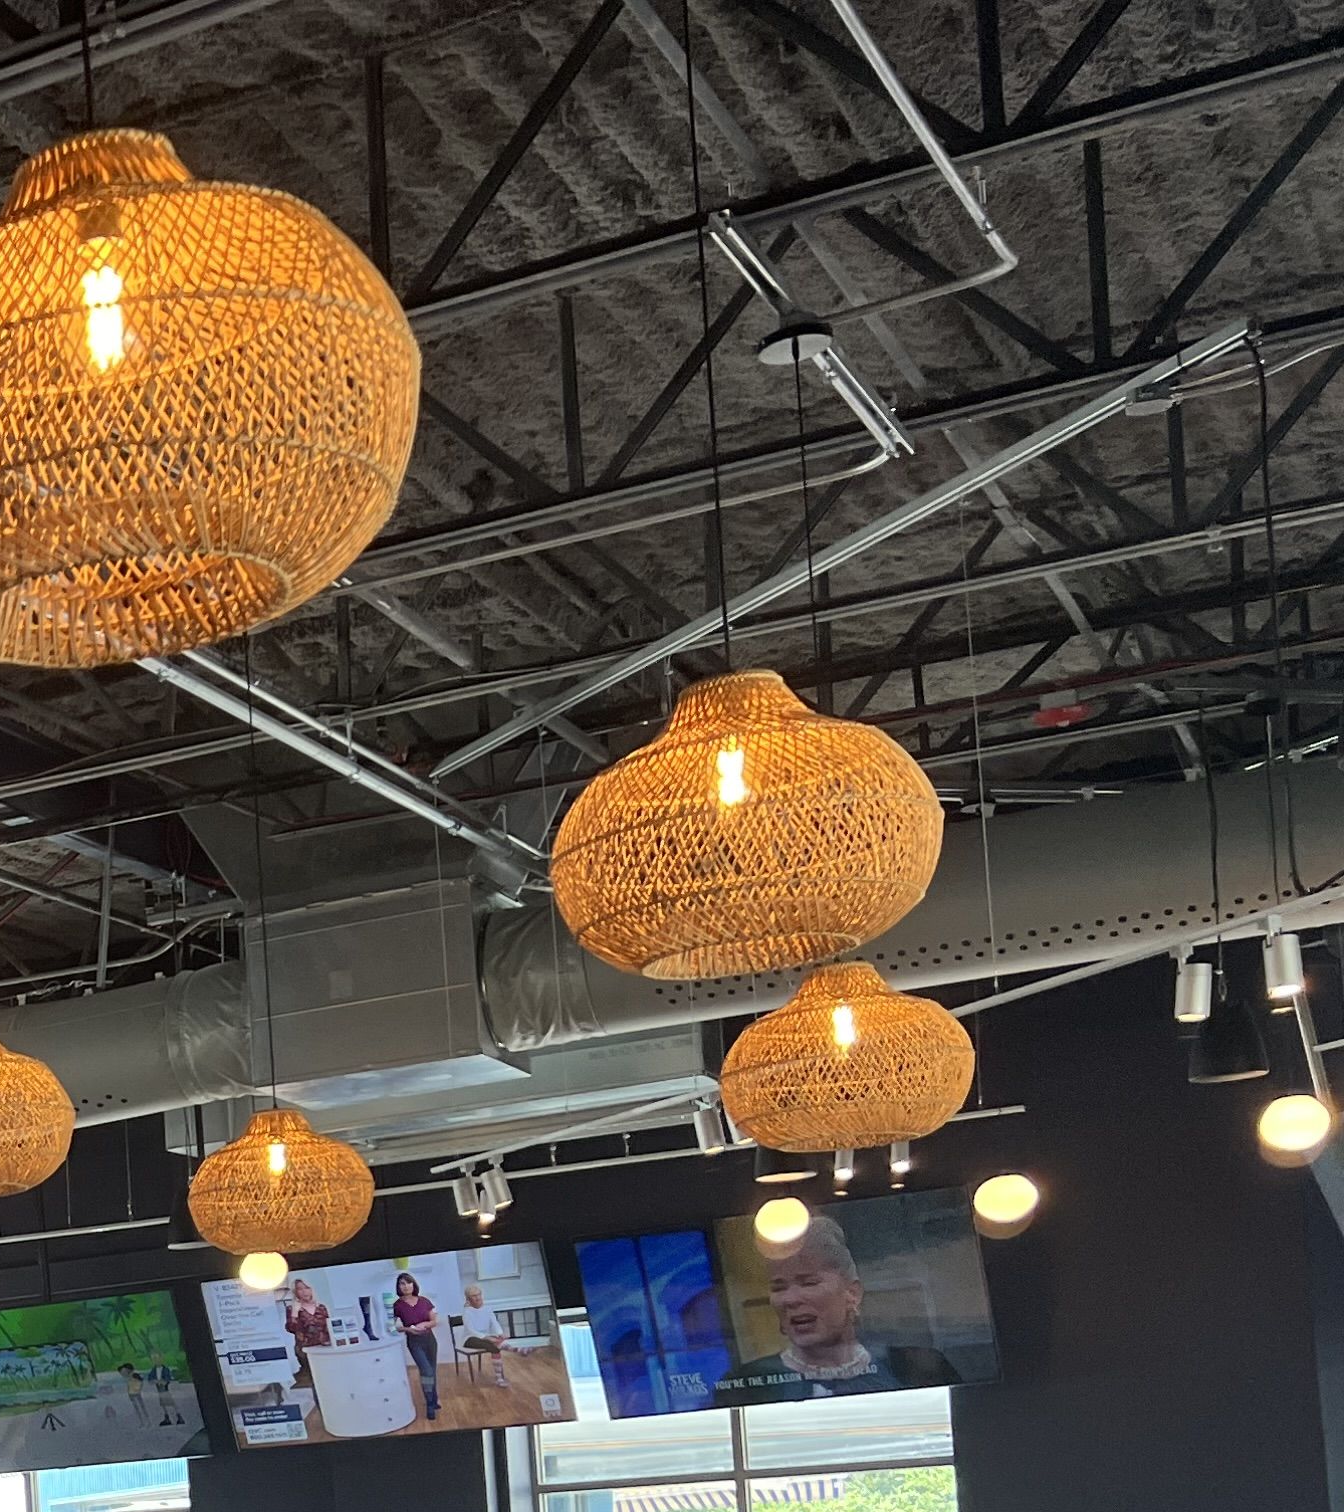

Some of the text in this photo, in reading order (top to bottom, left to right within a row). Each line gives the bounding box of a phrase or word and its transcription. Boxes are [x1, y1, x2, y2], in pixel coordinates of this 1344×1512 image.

[669, 1371, 702, 1386] STEVE
[713, 1378, 745, 1390] YOU'RE
[748, 1376, 765, 1387] THE
[767, 1373, 802, 1385] REASON
